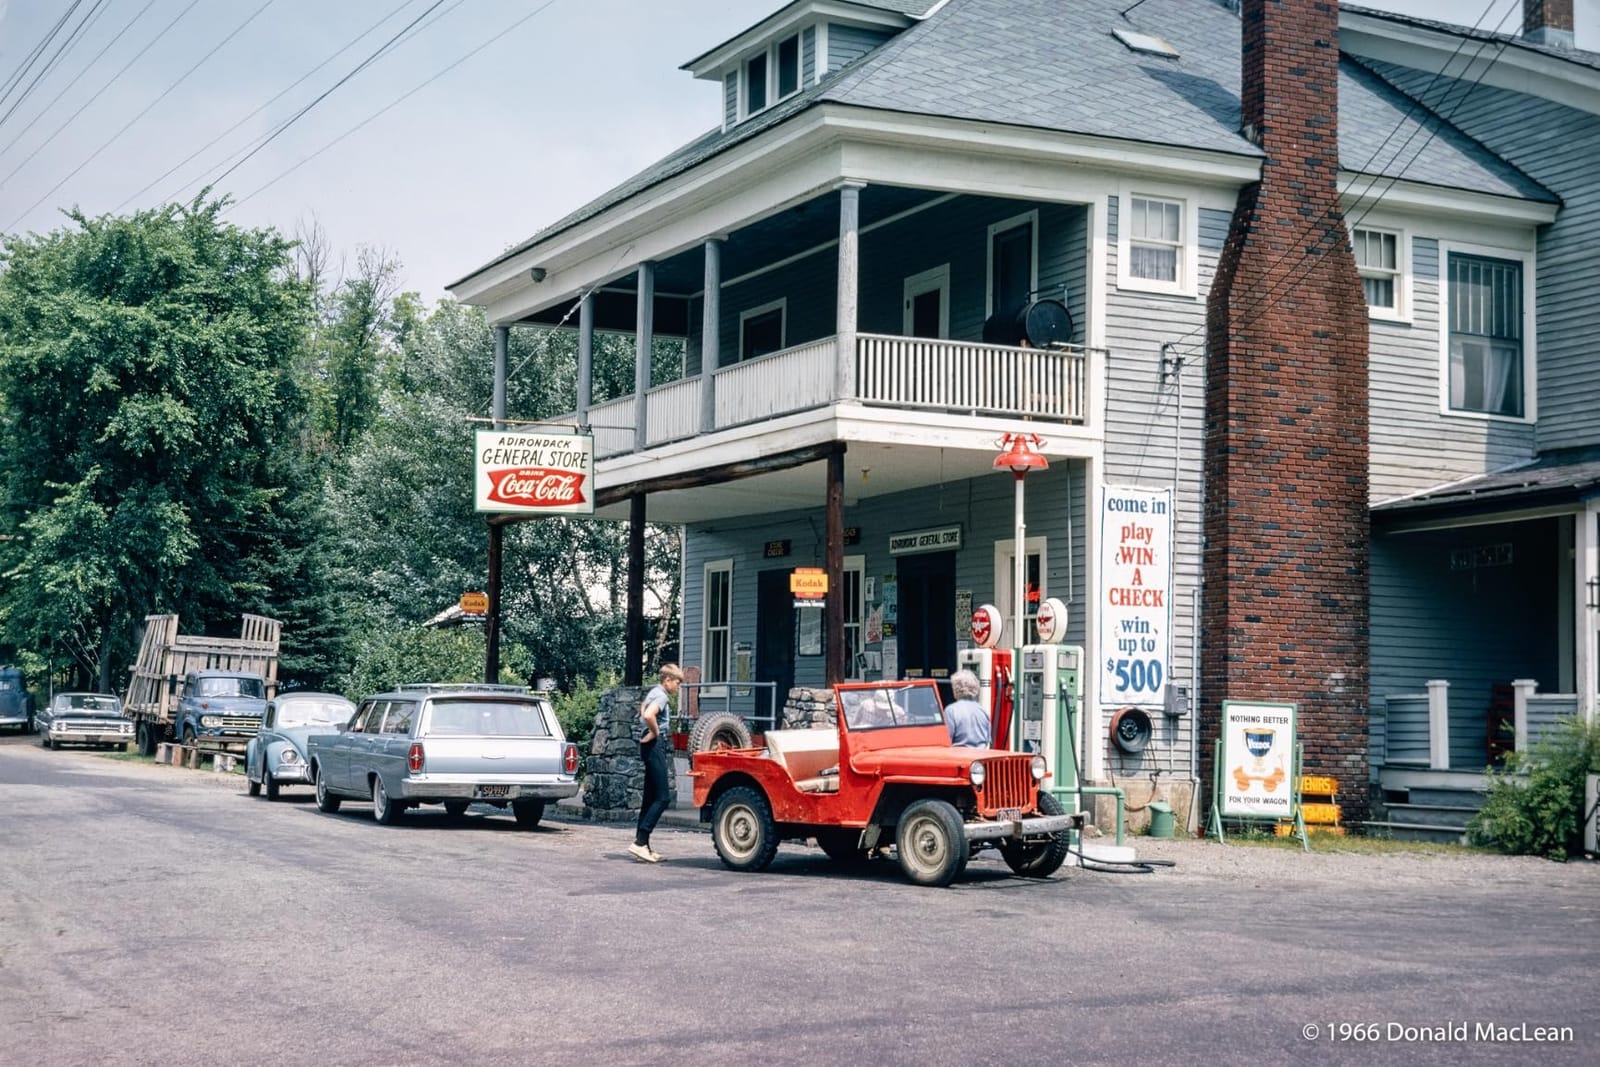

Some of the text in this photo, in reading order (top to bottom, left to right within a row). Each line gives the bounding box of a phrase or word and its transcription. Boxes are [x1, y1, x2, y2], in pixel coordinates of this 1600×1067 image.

[499, 437, 572, 448] ADIRONDACK
[482, 448, 588, 469] GENERAL STORE
[497, 473, 577, 500] Coca-Cola
[1107, 497, 1166, 514] come in
[1120, 522, 1153, 544] play
[1119, 546, 1153, 565] WIN
[795, 579, 824, 588] Kodak
[1131, 567, 1143, 586] A
[1108, 587, 1164, 607] CHECK
[1120, 615, 1150, 634] win
[1118, 637, 1156, 656] up to
[1107, 656, 1163, 694] $500
[1230, 715, 1289, 725] NOTHING BETTER
[1229, 796, 1288, 806] FOR YOUR WAGON
